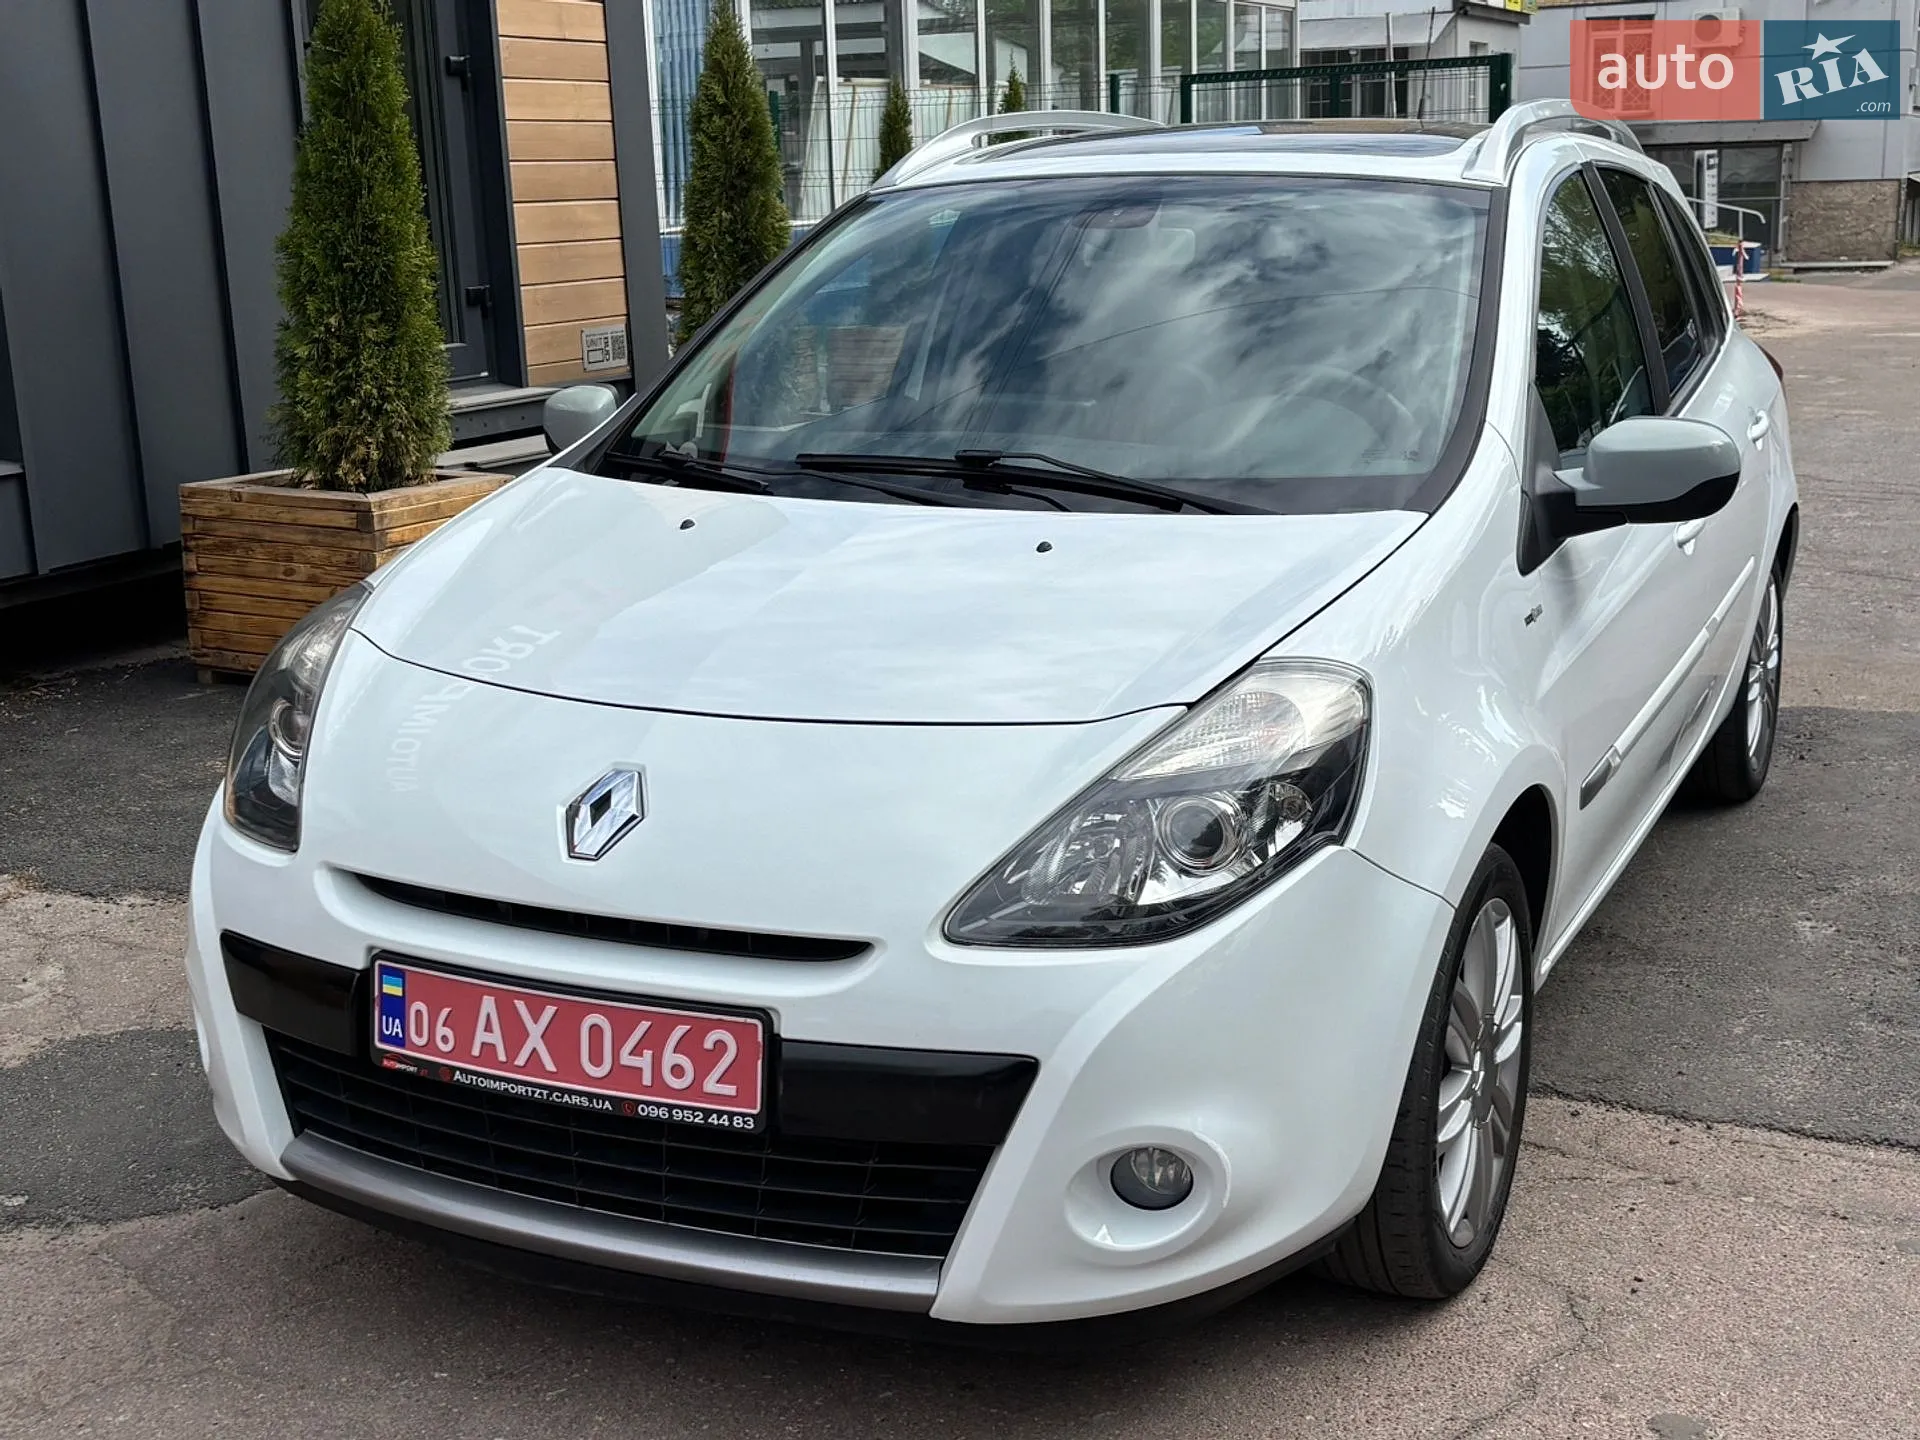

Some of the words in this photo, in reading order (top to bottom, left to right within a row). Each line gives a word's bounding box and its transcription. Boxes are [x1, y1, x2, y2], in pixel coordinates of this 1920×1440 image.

[382, 1015, 403, 1038] UA
[409, 1001, 456, 1053] 06
[471, 995, 558, 1073] AX
[580, 1013, 739, 1097] 0462
[637, 1104, 669, 1119] 096
[672, 1109, 704, 1124] 952
[708, 1113, 729, 1126] 44
[733, 1116, 755, 1129] 83
